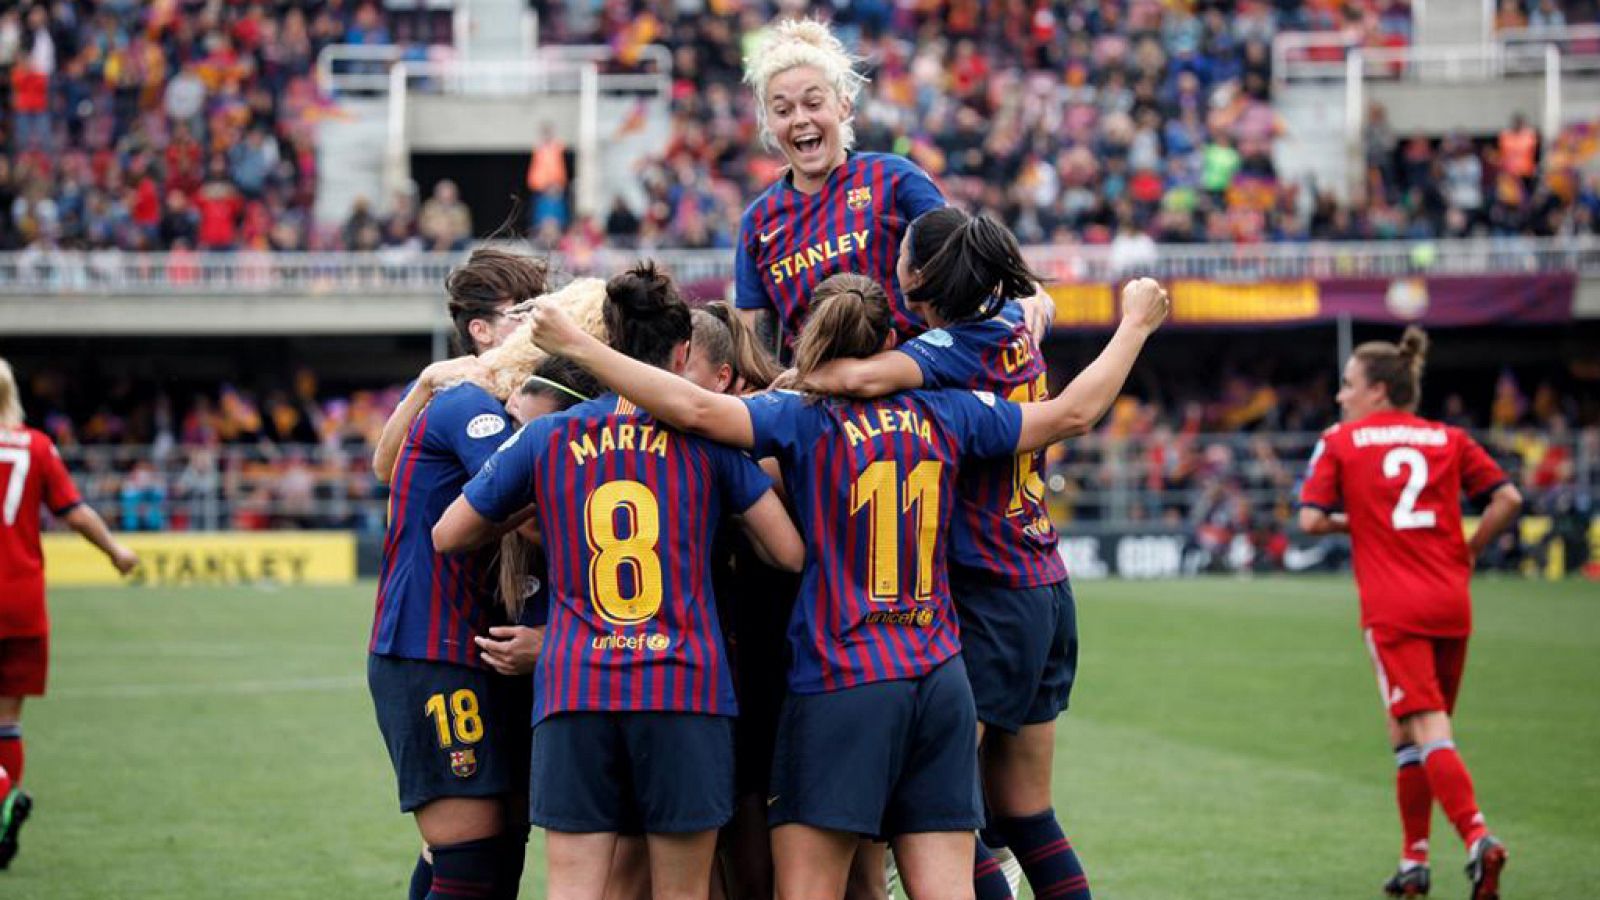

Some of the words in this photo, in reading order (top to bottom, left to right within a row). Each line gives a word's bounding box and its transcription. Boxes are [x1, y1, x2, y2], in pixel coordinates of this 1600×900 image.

[770, 229, 869, 285] STANLEY
[569, 424, 669, 465] MARTA
[843, 408, 932, 447] ALEXIA
[1383, 447, 1436, 529] 2
[584, 480, 663, 626] 8
[850, 460, 942, 602] 11
[592, 630, 648, 650] unicef
[425, 688, 484, 749] 18
